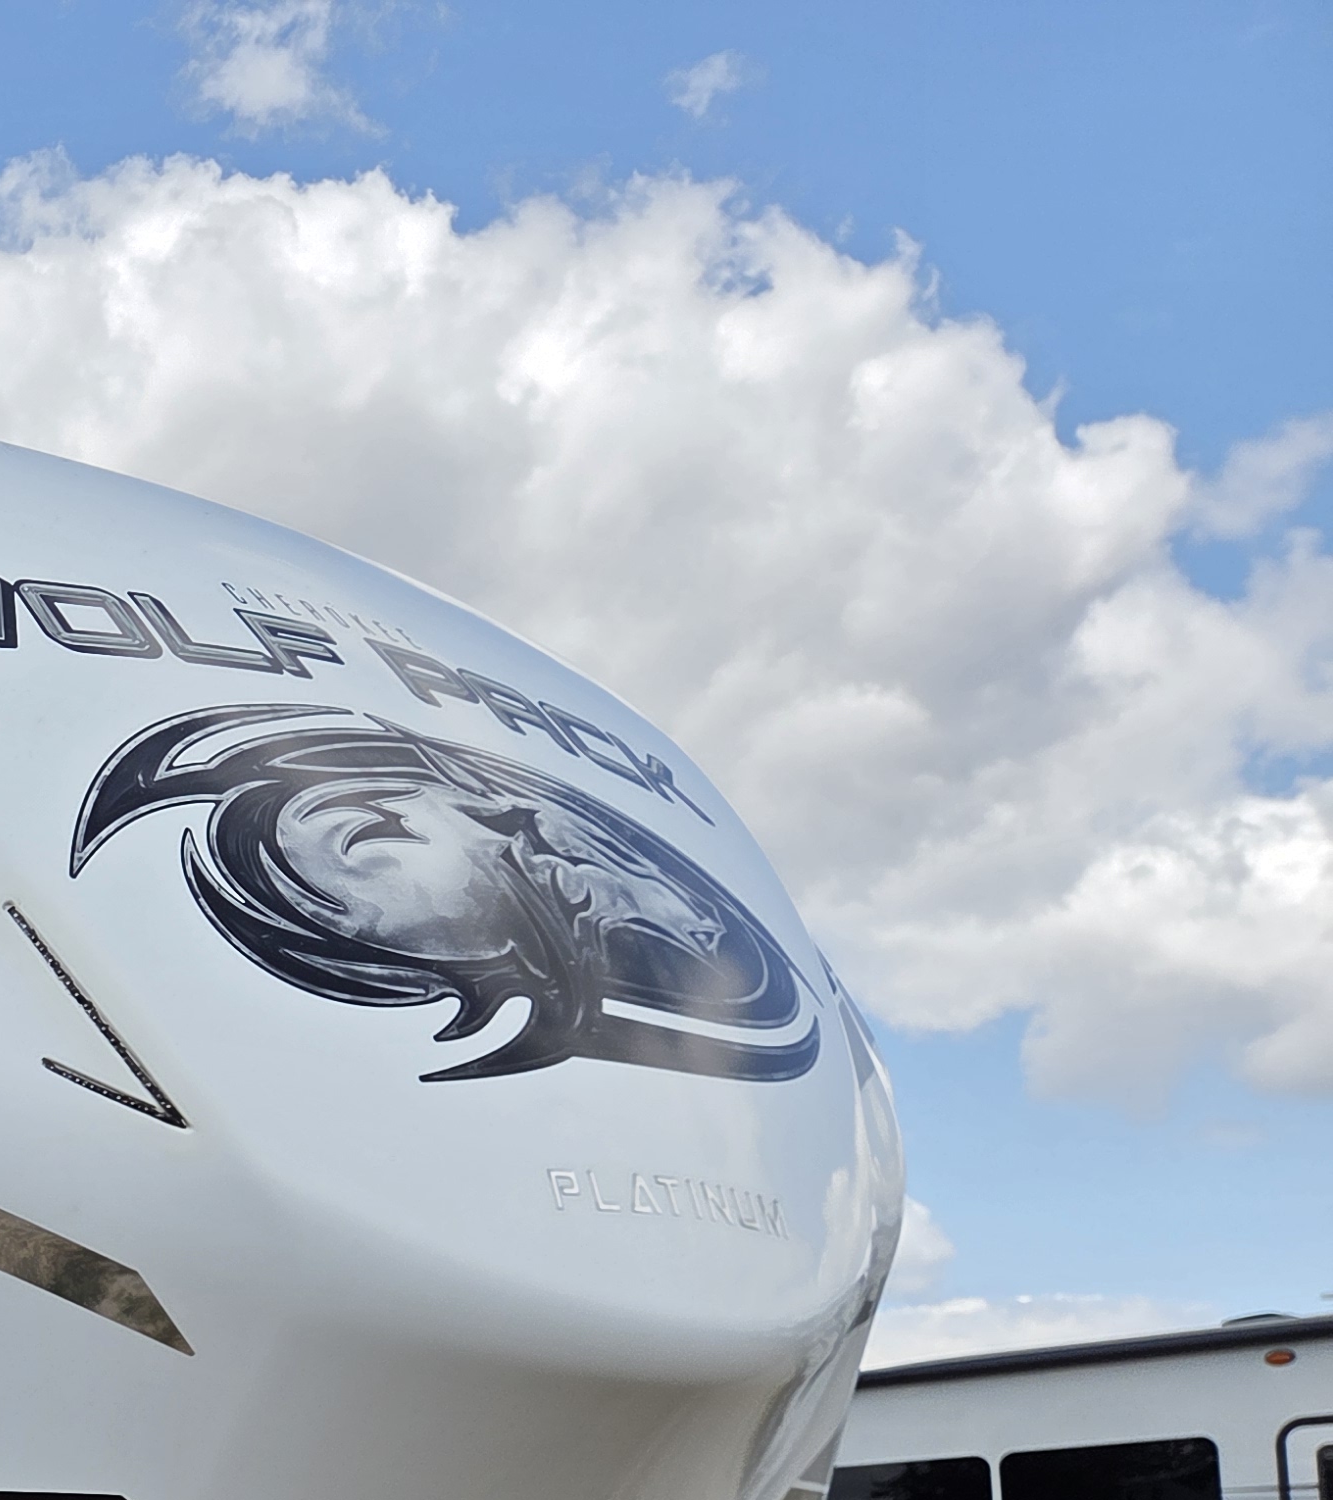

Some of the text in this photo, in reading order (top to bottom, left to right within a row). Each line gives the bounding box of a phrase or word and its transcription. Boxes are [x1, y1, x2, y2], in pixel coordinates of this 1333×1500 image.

[220, 582, 423, 650] CHEROKEE
[363, 637, 716, 828] PACK
[546, 1168, 790, 1241] PLATINUM
